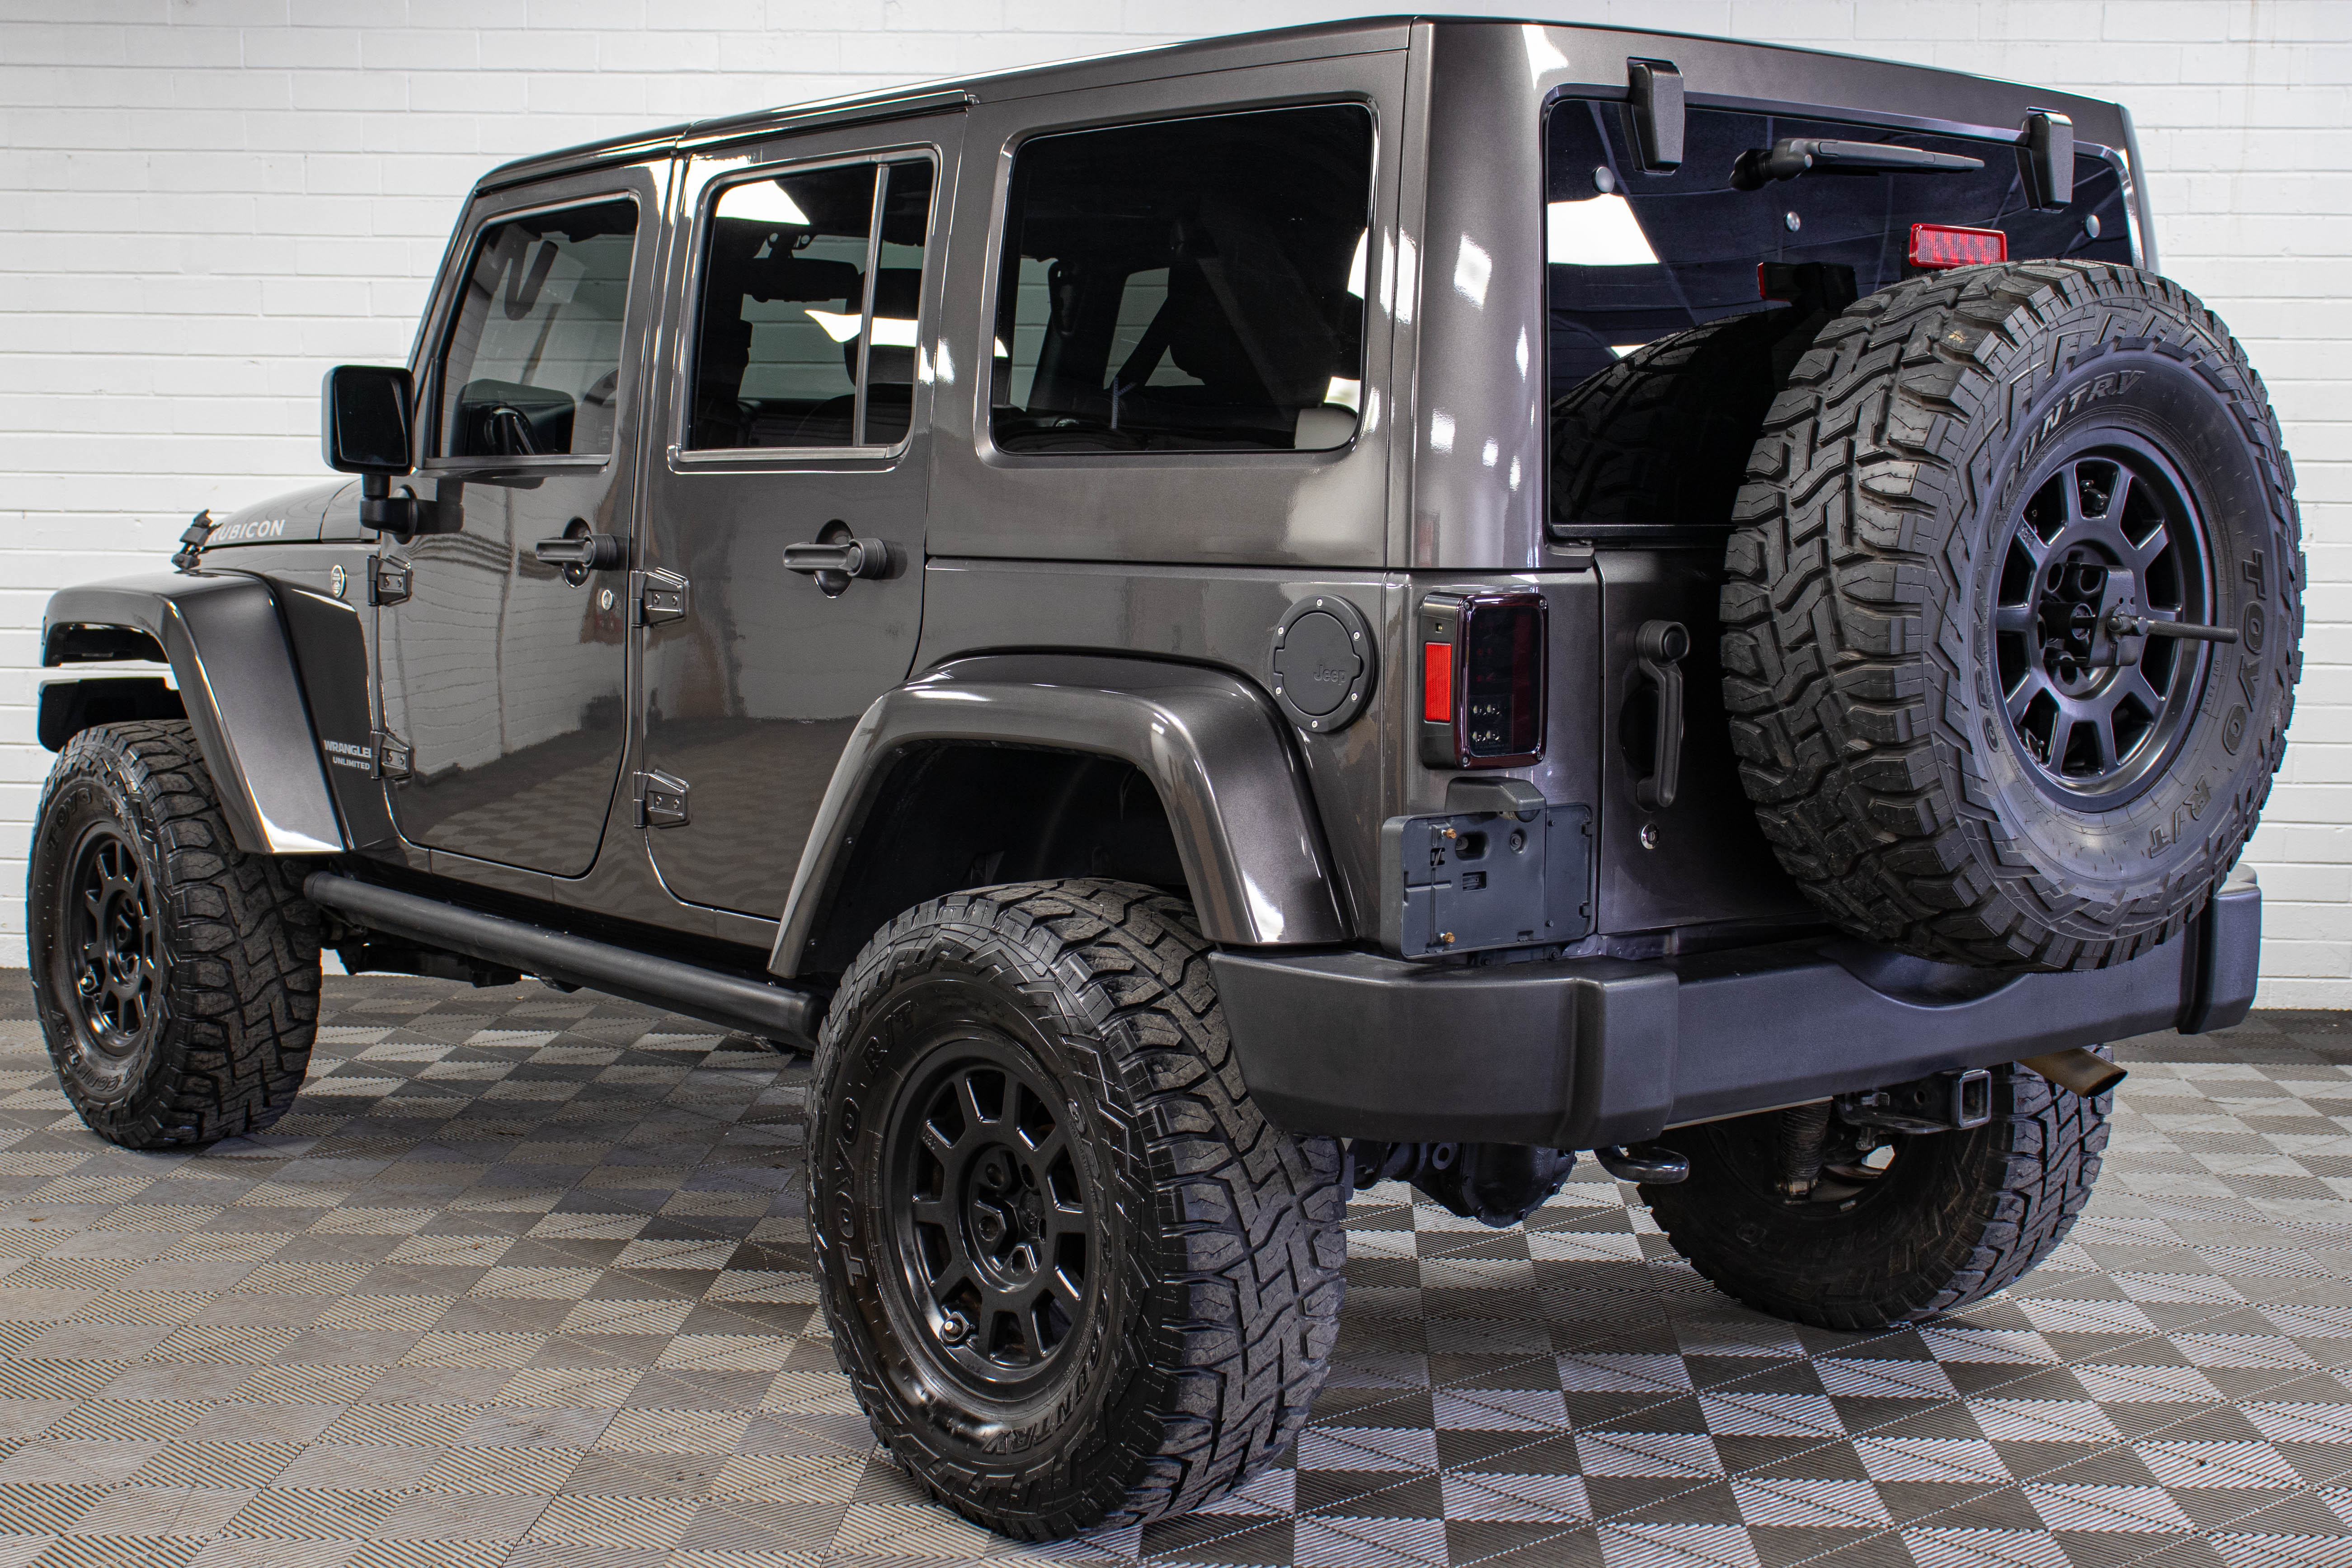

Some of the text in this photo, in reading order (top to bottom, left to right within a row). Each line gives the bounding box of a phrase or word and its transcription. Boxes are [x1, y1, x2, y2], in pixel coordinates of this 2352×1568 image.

[208, 519, 286, 542] RUBICON
[1313, 664, 1346, 685] Jeep
[2149, 549, 2266, 857] TOYO R/T
[324, 740, 372, 758] WRANGLE
[333, 756, 370, 770] UNLIMITED
[834, 1000, 914, 1287] TOYO R/T
